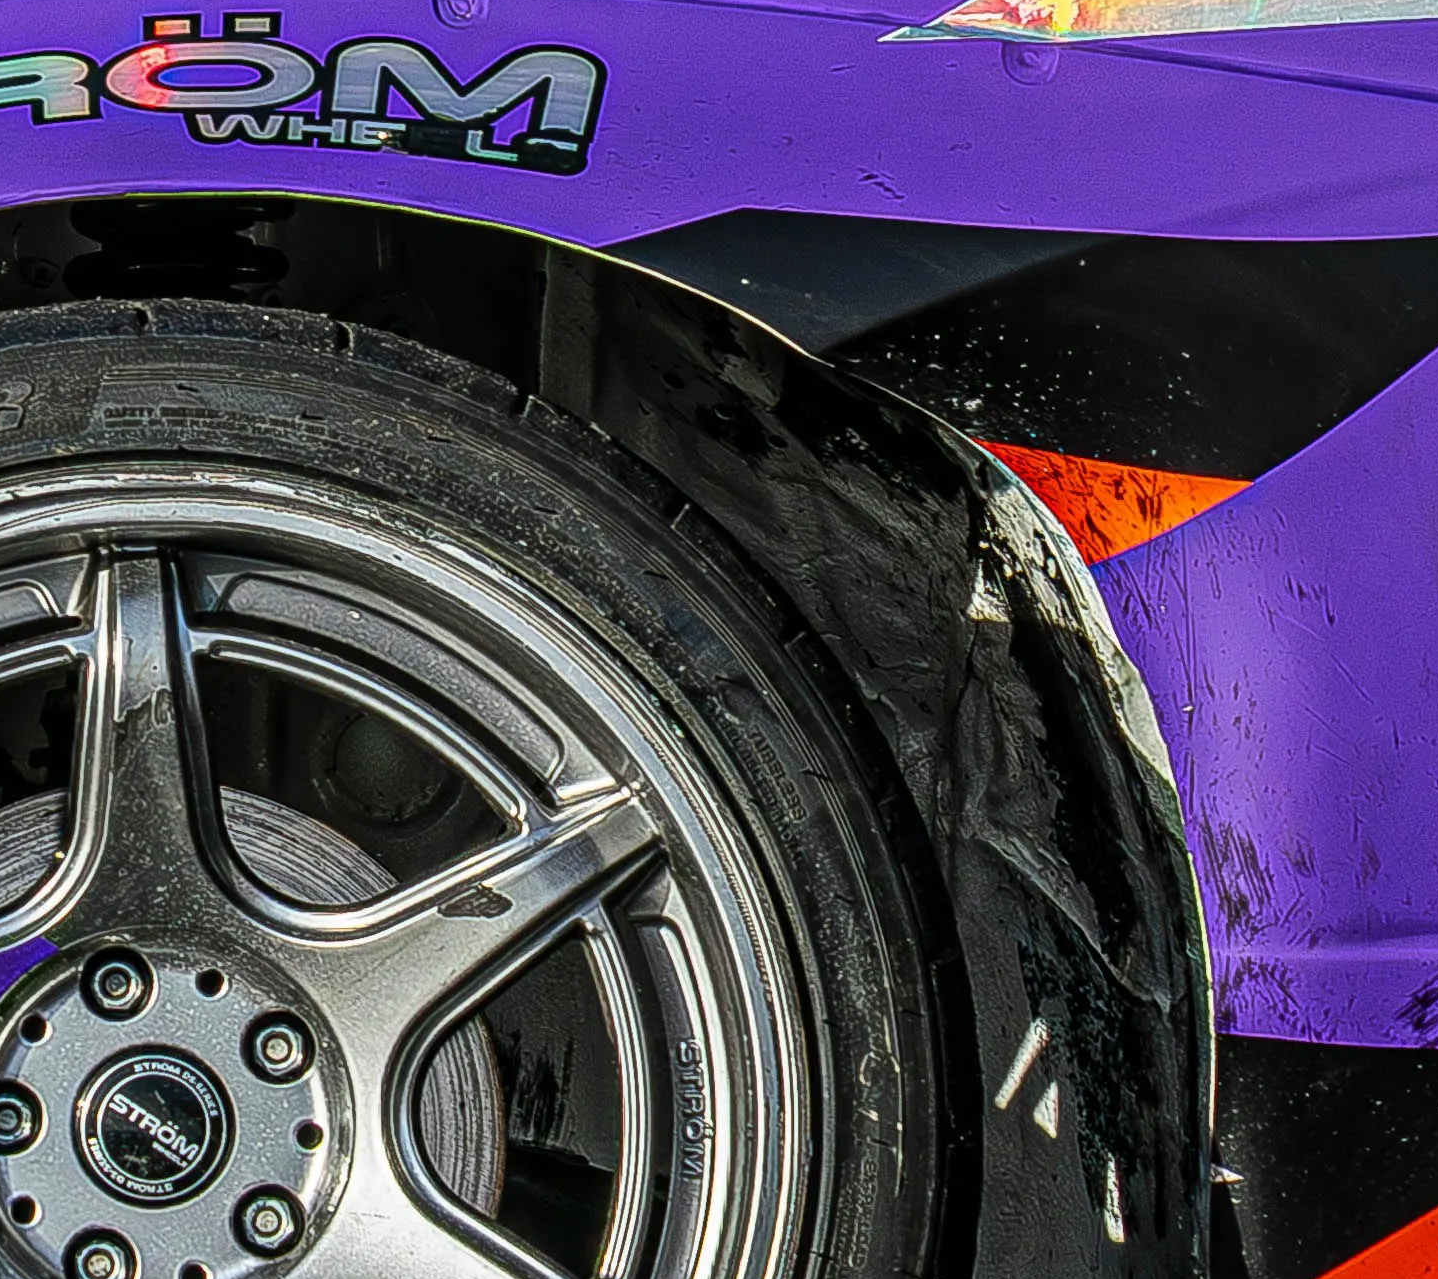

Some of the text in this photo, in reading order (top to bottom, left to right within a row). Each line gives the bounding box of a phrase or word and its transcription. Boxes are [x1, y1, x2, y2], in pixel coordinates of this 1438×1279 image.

[194, 110, 580, 164] WHEL
[108, 1092, 200, 1161] STRÖM
[675, 1038, 715, 1180] STRÖM
